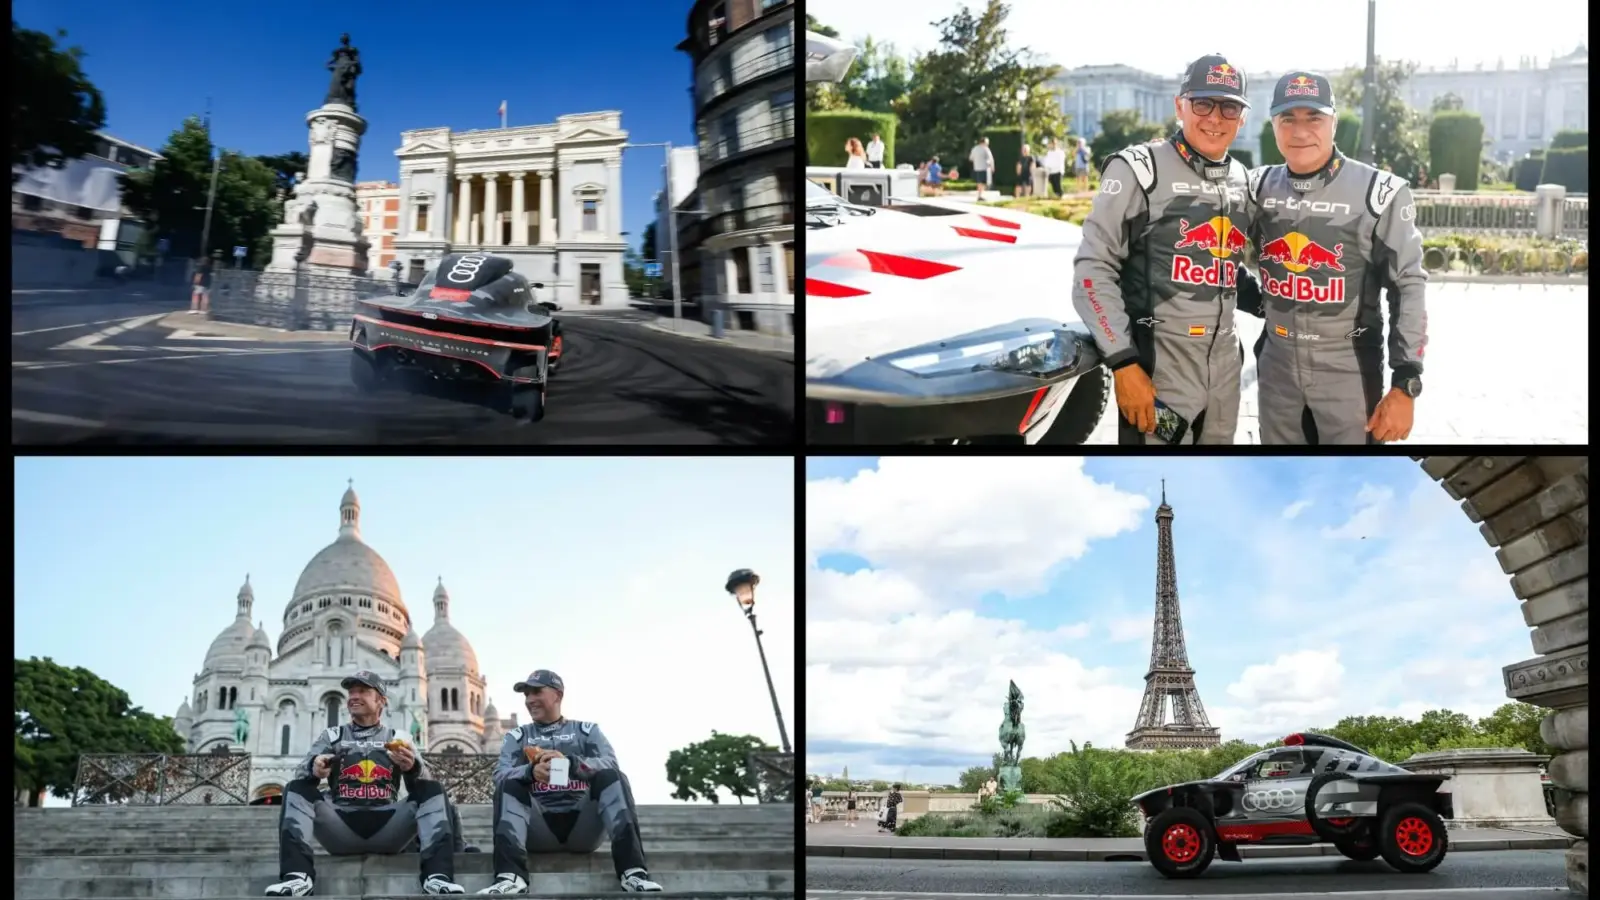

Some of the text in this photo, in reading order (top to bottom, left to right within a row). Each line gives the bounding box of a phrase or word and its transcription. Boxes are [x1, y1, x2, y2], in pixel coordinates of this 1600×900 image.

[1206, 75, 1240, 89] Red Bull
[1285, 86, 1319, 97] Red Bull
[1263, 197, 1350, 216] e-tron
[1172, 254, 1221, 285] Red
[1260, 267, 1346, 304] Red Bull
[338, 783, 367, 799] Red
